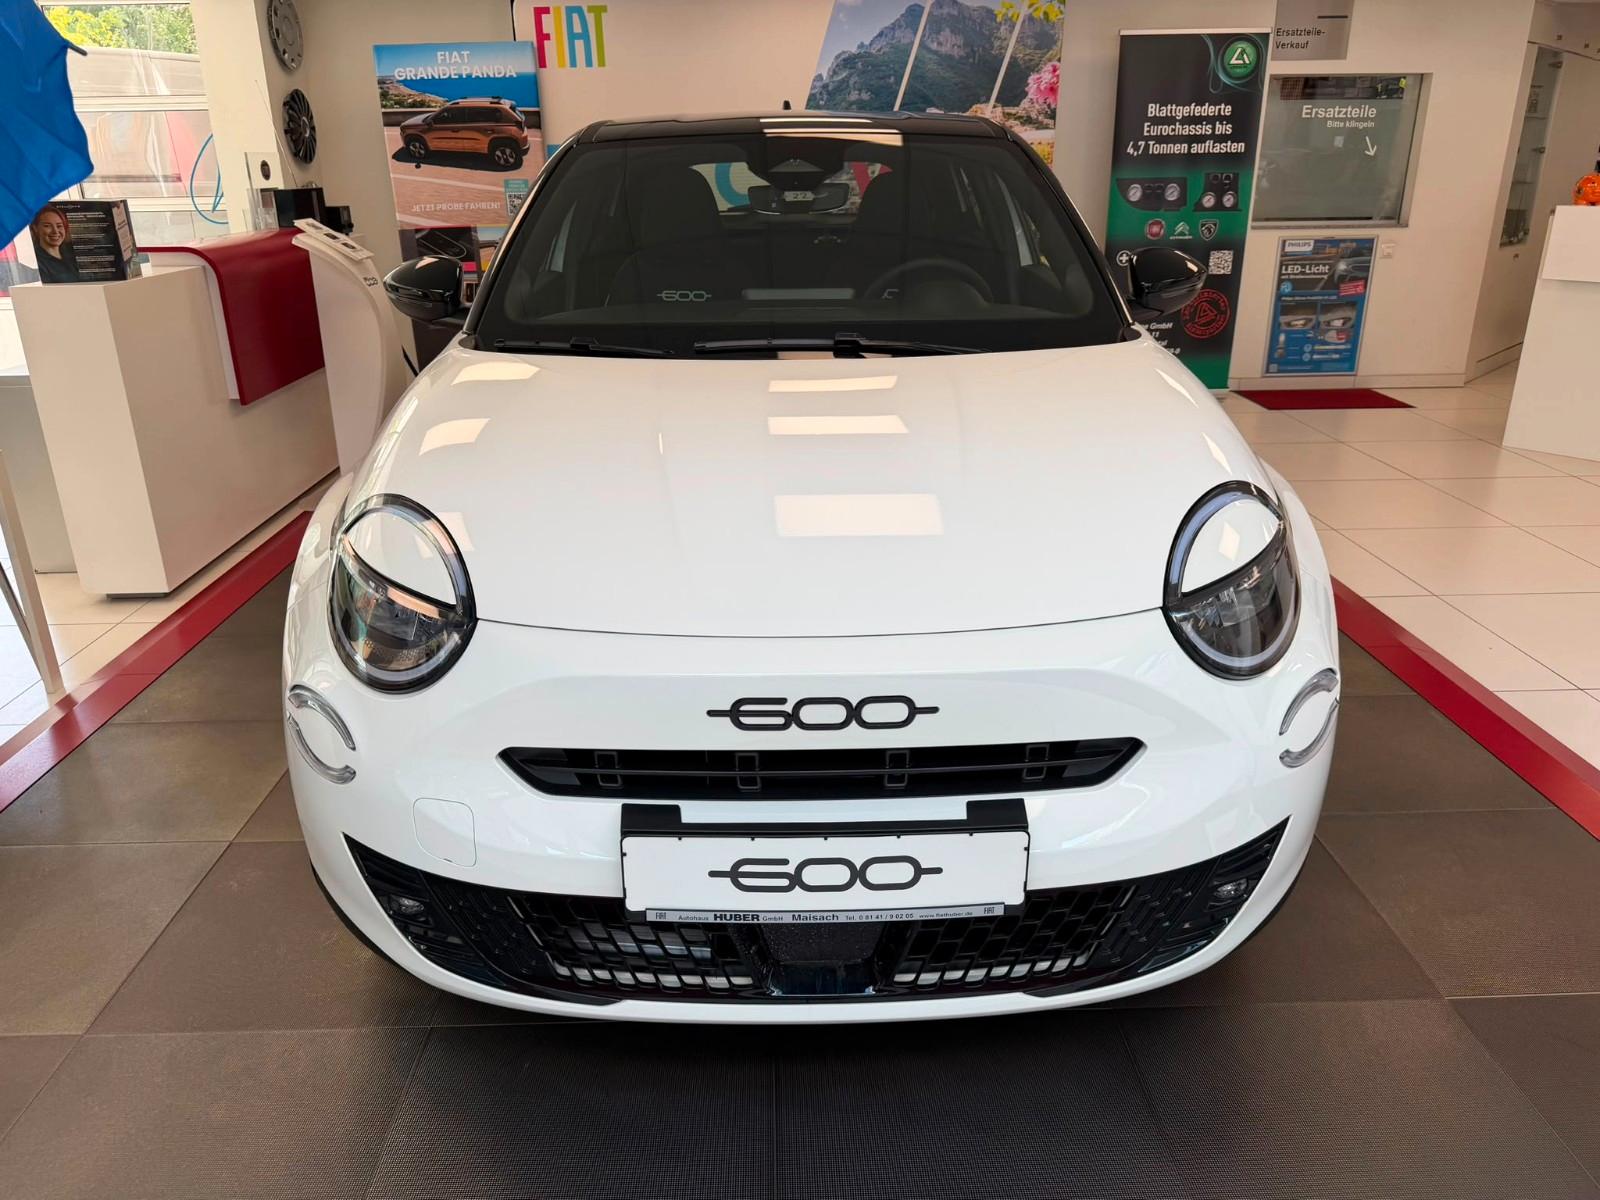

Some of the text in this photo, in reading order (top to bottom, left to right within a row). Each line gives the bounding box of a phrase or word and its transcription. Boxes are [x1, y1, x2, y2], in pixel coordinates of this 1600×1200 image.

[533, 5, 608, 68] FIAT
[1276, 28, 1326, 37] Ersatzteile-
[1275, 40, 1309, 49] Verkauf
[437, 51, 471, 64] FIAT
[394, 65, 517, 80] GRANDE PANDA
[1147, 102, 1232, 119] Blattgefederte
[1302, 105, 1377, 118] Ersatzteile
[1143, 121, 1233, 136] Eurochassis bis
[1327, 120, 1375, 129] Bitte klingeln
[1126, 140, 1245, 157] 4,7 Tonnen auflasten
[411, 203, 435, 213] JETZT
[1281, 264, 1330, 274] LED-Licht
[1150, 322, 1173, 330] GmbH
[707, 695, 939, 731] 600
[708, 855, 943, 893] 600
[983, 906, 995, 915] FIAT
[713, 913, 760, 922] HUBER
[791, 913, 839, 922] Maisach
